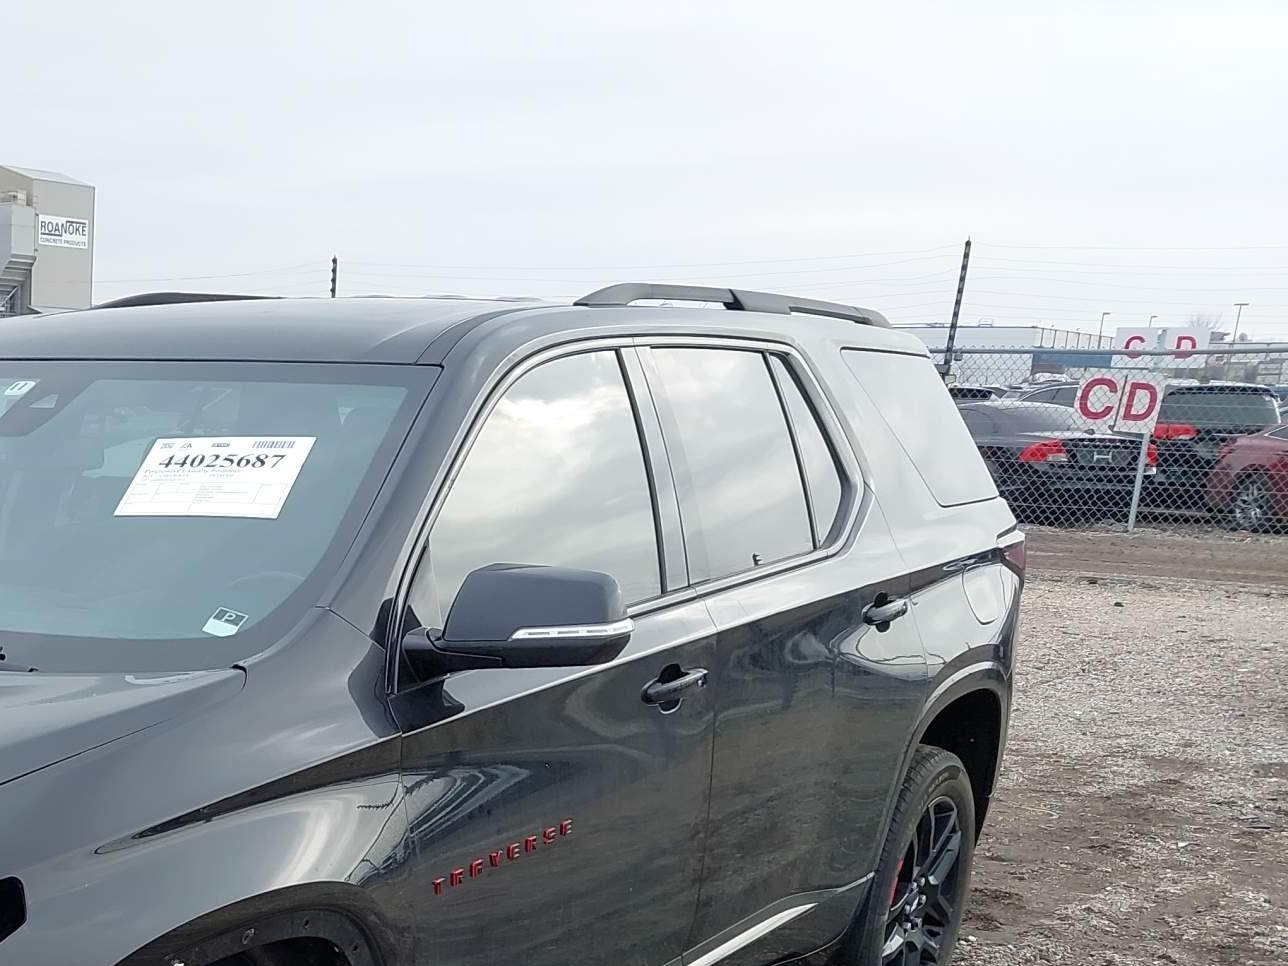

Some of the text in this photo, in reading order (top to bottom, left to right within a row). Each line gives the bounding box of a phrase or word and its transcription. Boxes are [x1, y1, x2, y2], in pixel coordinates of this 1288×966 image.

[40, 220, 87, 237] ROANOKE
[1124, 335, 1197, 360] C D
[158, 453, 287, 469] 44025687
[431, 817, 575, 897] TRAVERSE
